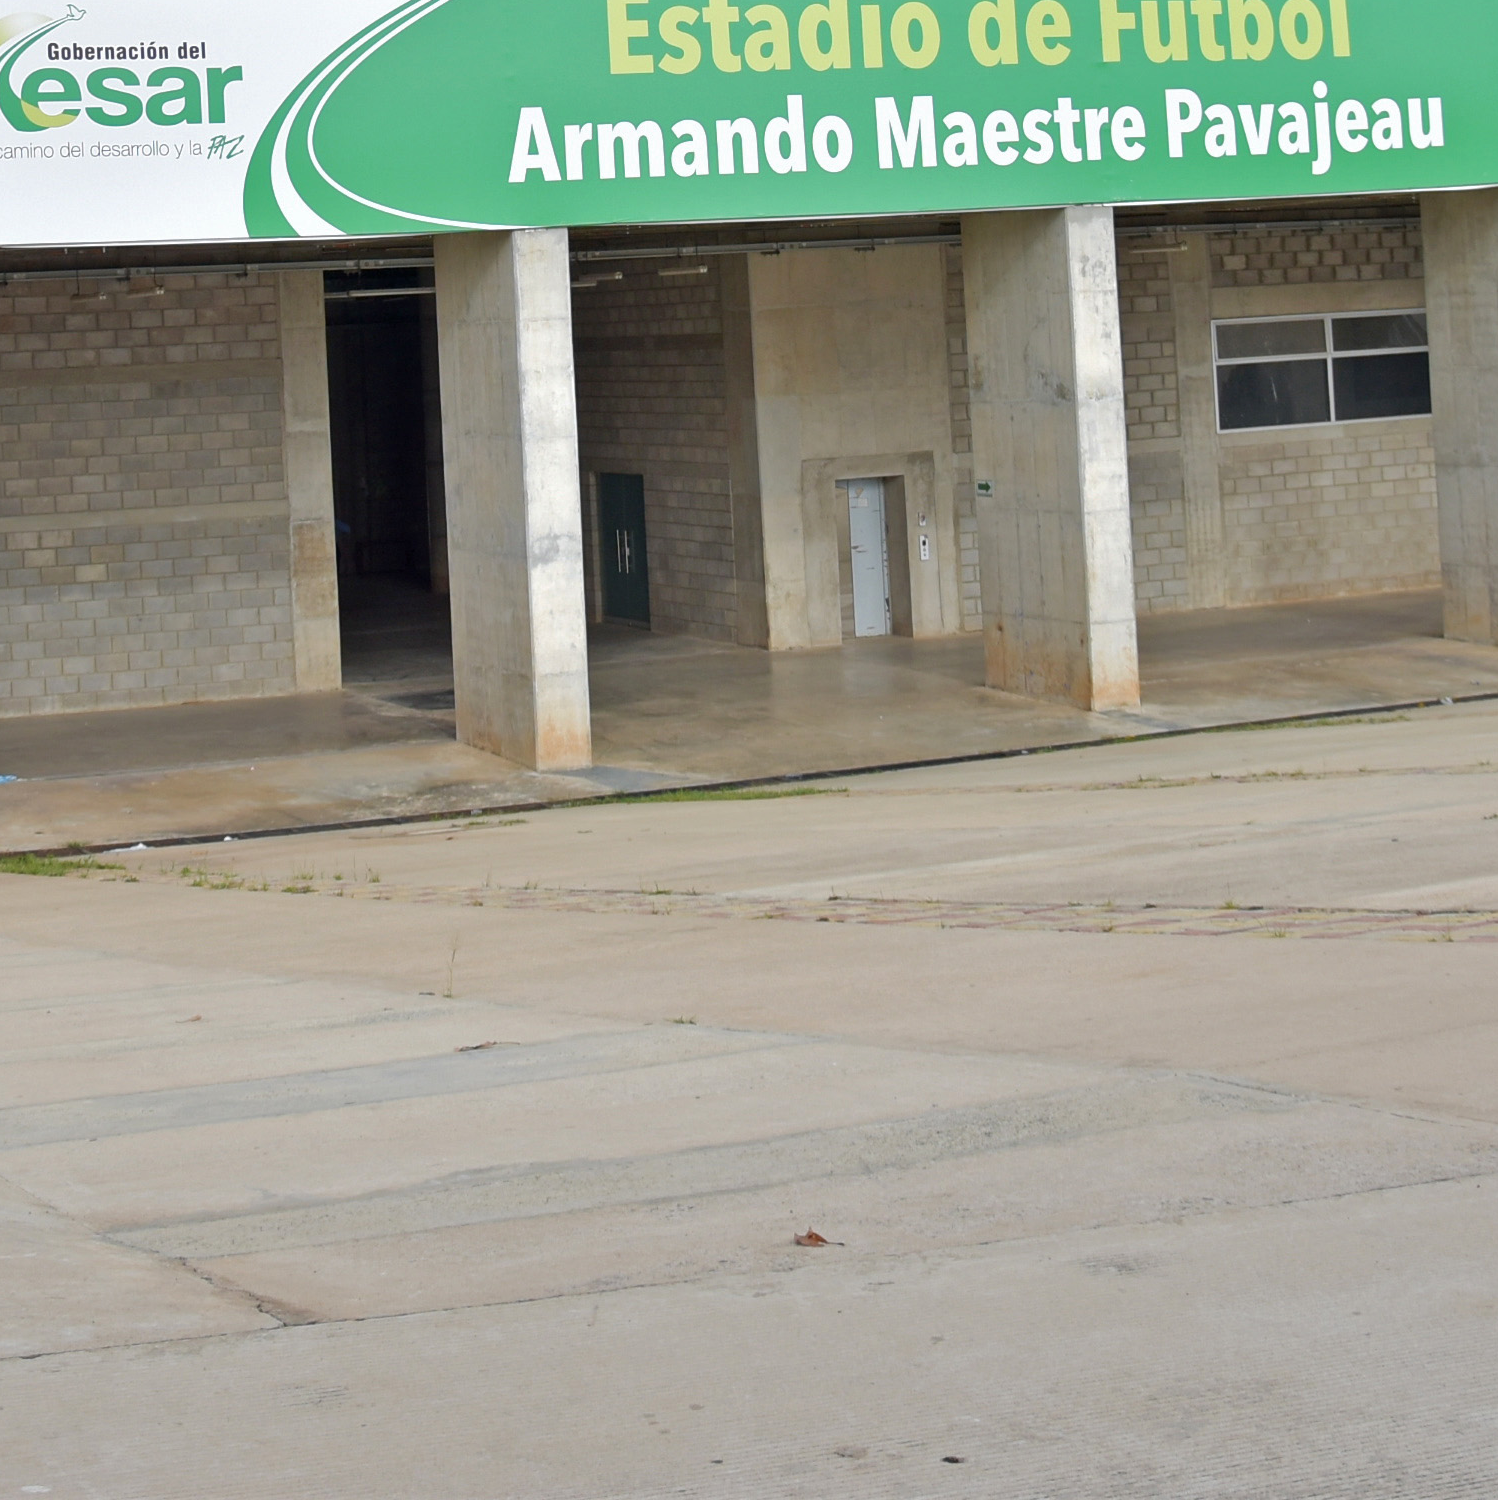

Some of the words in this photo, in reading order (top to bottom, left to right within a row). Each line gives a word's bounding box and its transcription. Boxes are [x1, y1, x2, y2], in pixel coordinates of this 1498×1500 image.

[47, 41, 169, 61] Gobernación
[177, 41, 206, 59] del
[507, 94, 853, 185] Armando
[878, 94, 1146, 171] Maestre
[1165, 80, 1446, 176] Pavajeau
[60, 141, 84, 158] del
[90, 140, 170, 158] desarrollo
[175, 146, 183, 159] y
[189, 140, 202, 156] la
